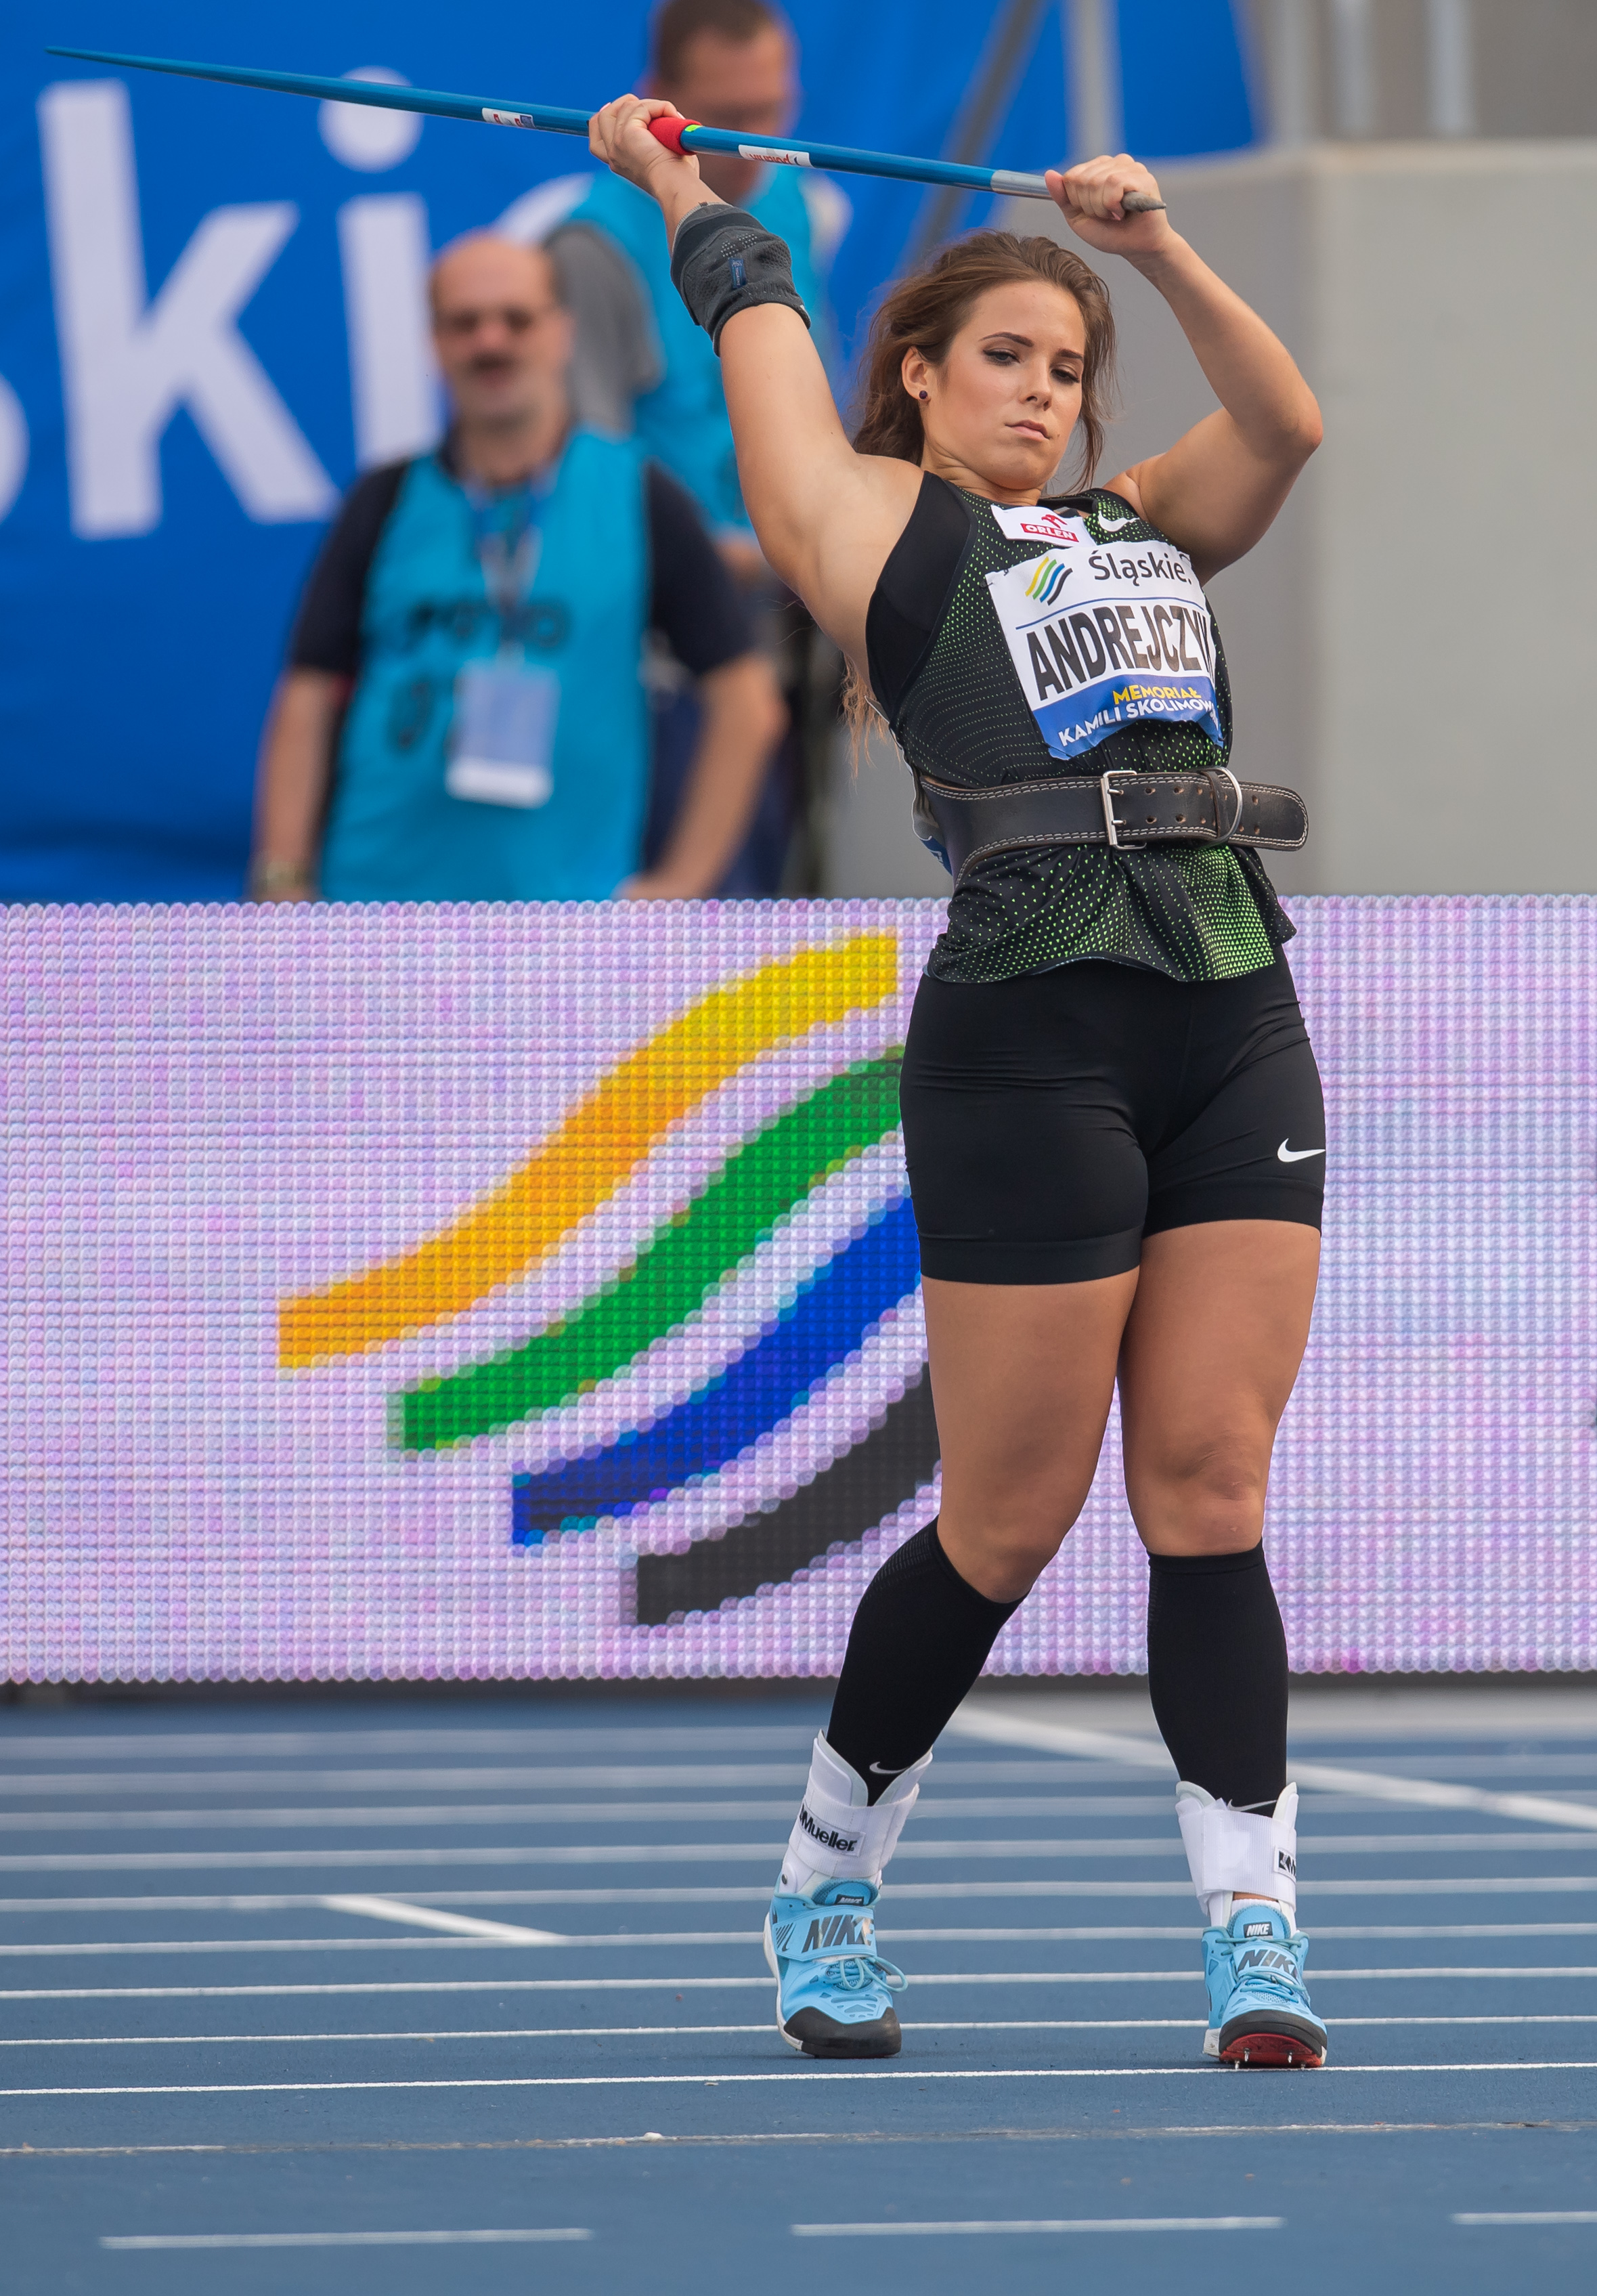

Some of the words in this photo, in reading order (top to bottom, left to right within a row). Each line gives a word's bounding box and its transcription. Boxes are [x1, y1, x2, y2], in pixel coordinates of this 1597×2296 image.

[1026, 525, 1074, 540] ORLEN
[1112, 685, 1202, 705] MEMORIAŁ
[1058, 706, 1122, 747] KAMILI
[1126, 698, 1219, 731] SKOLIMOW
[802, 1810, 858, 1852] Mueller
[801, 1914, 874, 1954] NIKE
[1246, 1924, 1270, 1936] NIKE
[1238, 1949, 1298, 1979] NIK
